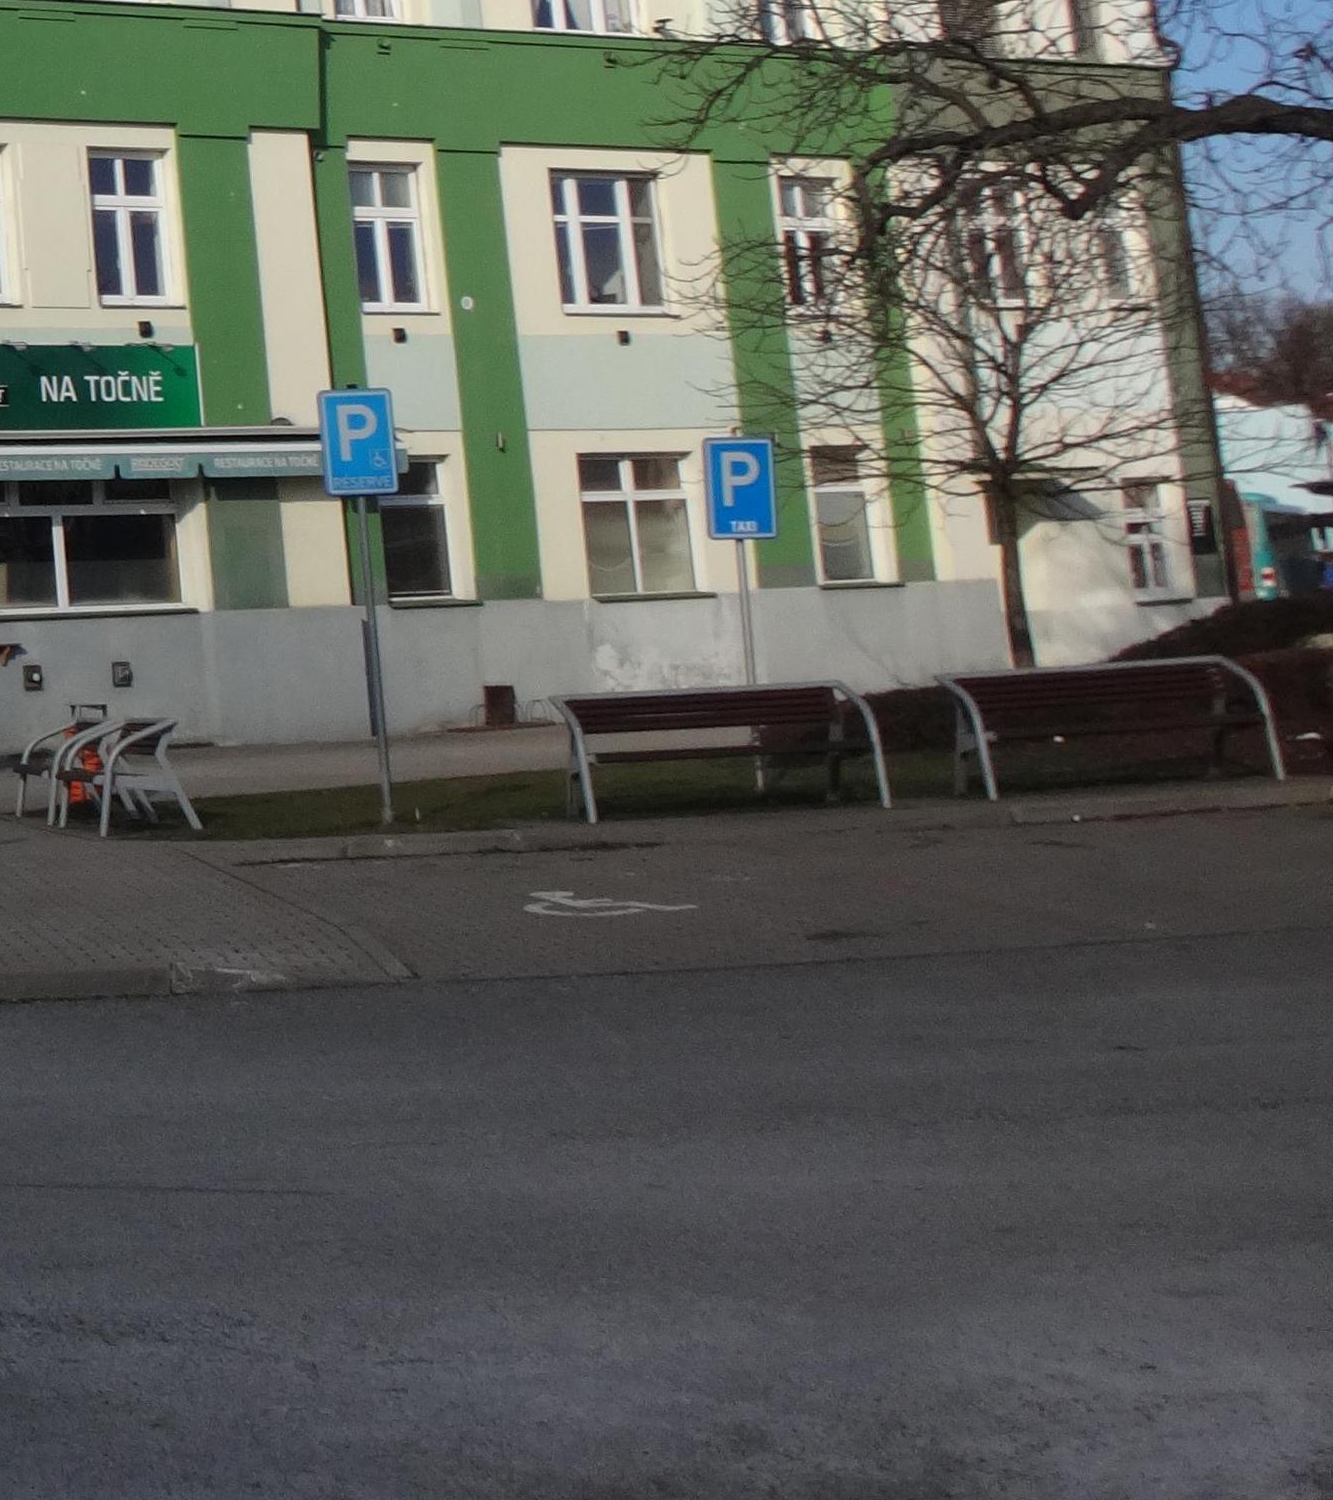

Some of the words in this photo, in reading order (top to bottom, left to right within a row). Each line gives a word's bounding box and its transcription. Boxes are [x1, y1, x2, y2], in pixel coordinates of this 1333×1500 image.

[40, 375, 78, 403] NA
[83, 370, 164, 403] TOČNĚ
[336, 404, 377, 462] P
[720, 451, 760, 507] P
